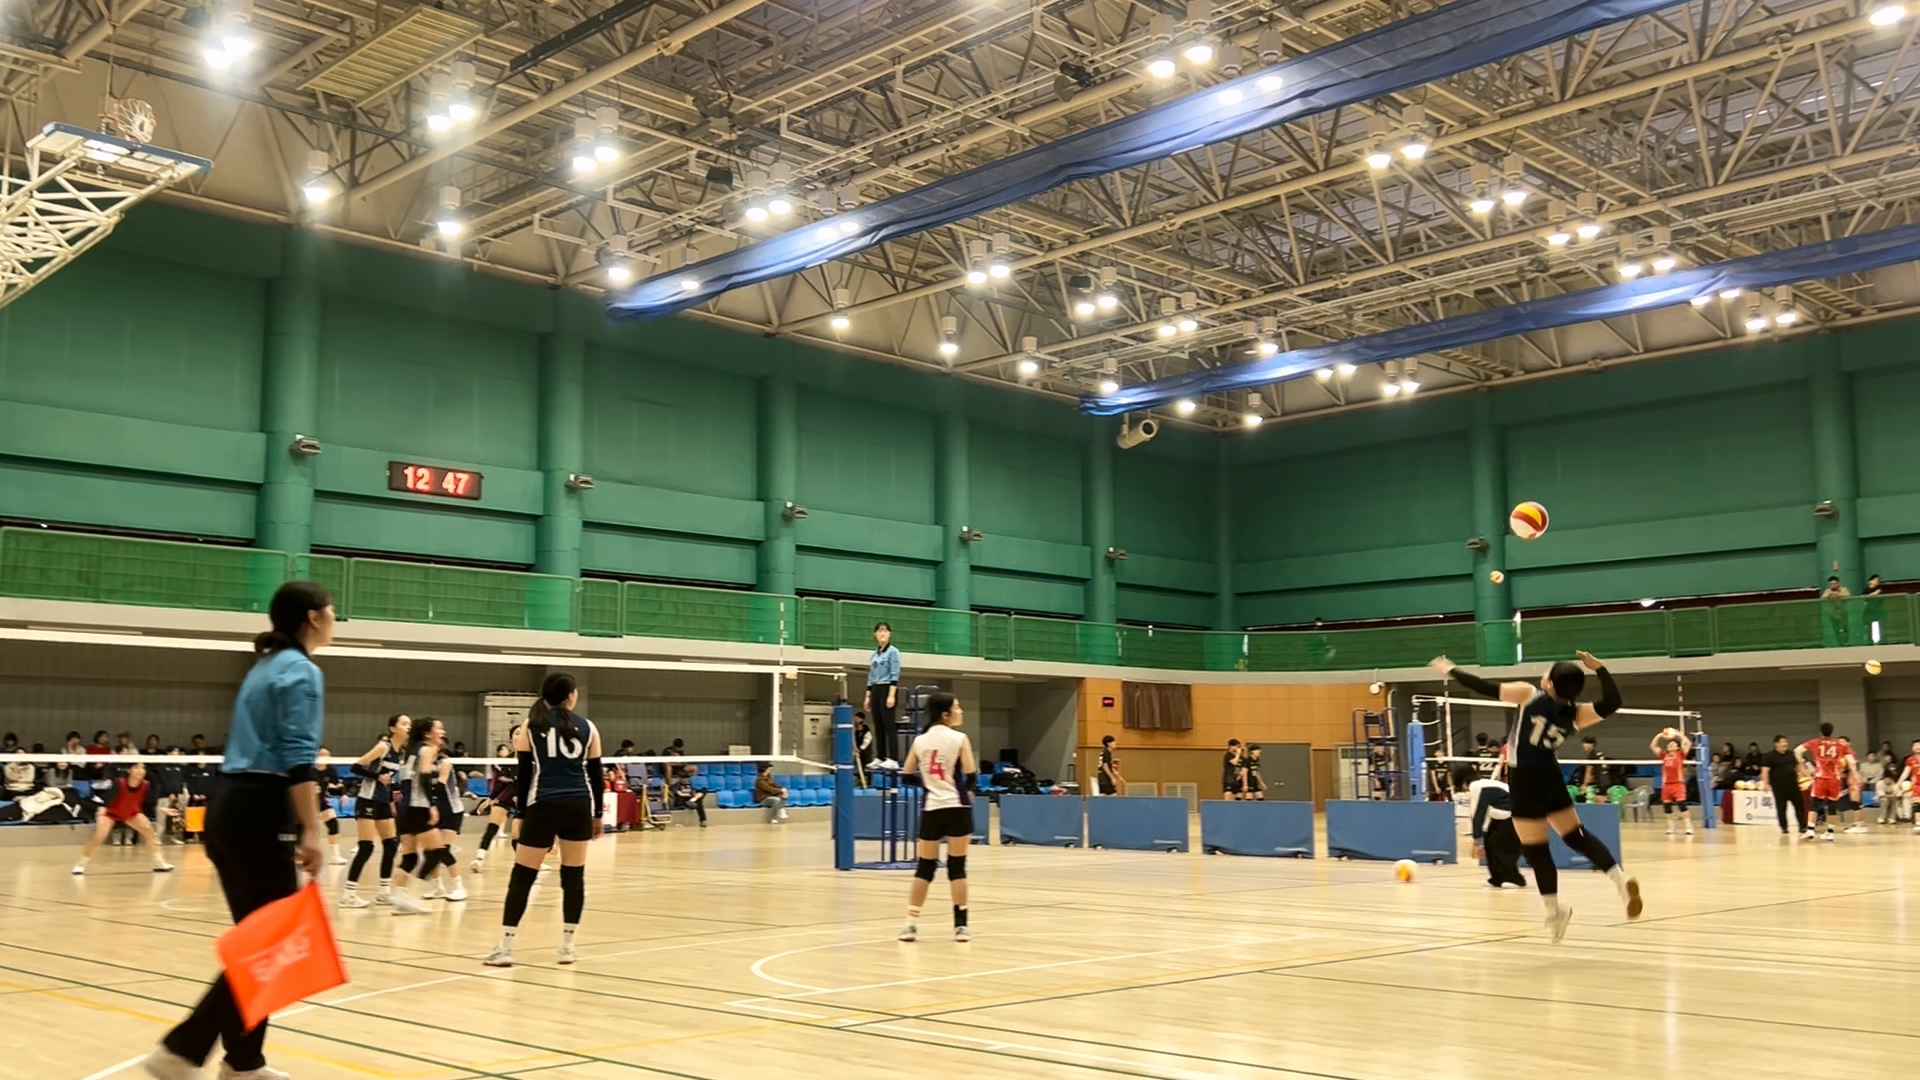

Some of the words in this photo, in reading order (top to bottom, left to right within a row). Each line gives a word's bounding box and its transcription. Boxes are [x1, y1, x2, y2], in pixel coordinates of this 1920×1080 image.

[403, 466, 431, 489] 12
[442, 471, 471, 495] 47
[540, 727, 583, 759] 16
[1529, 715, 1567, 749] 15
[928, 749, 946, 781] 4
[1818, 745, 1837, 758] 14
